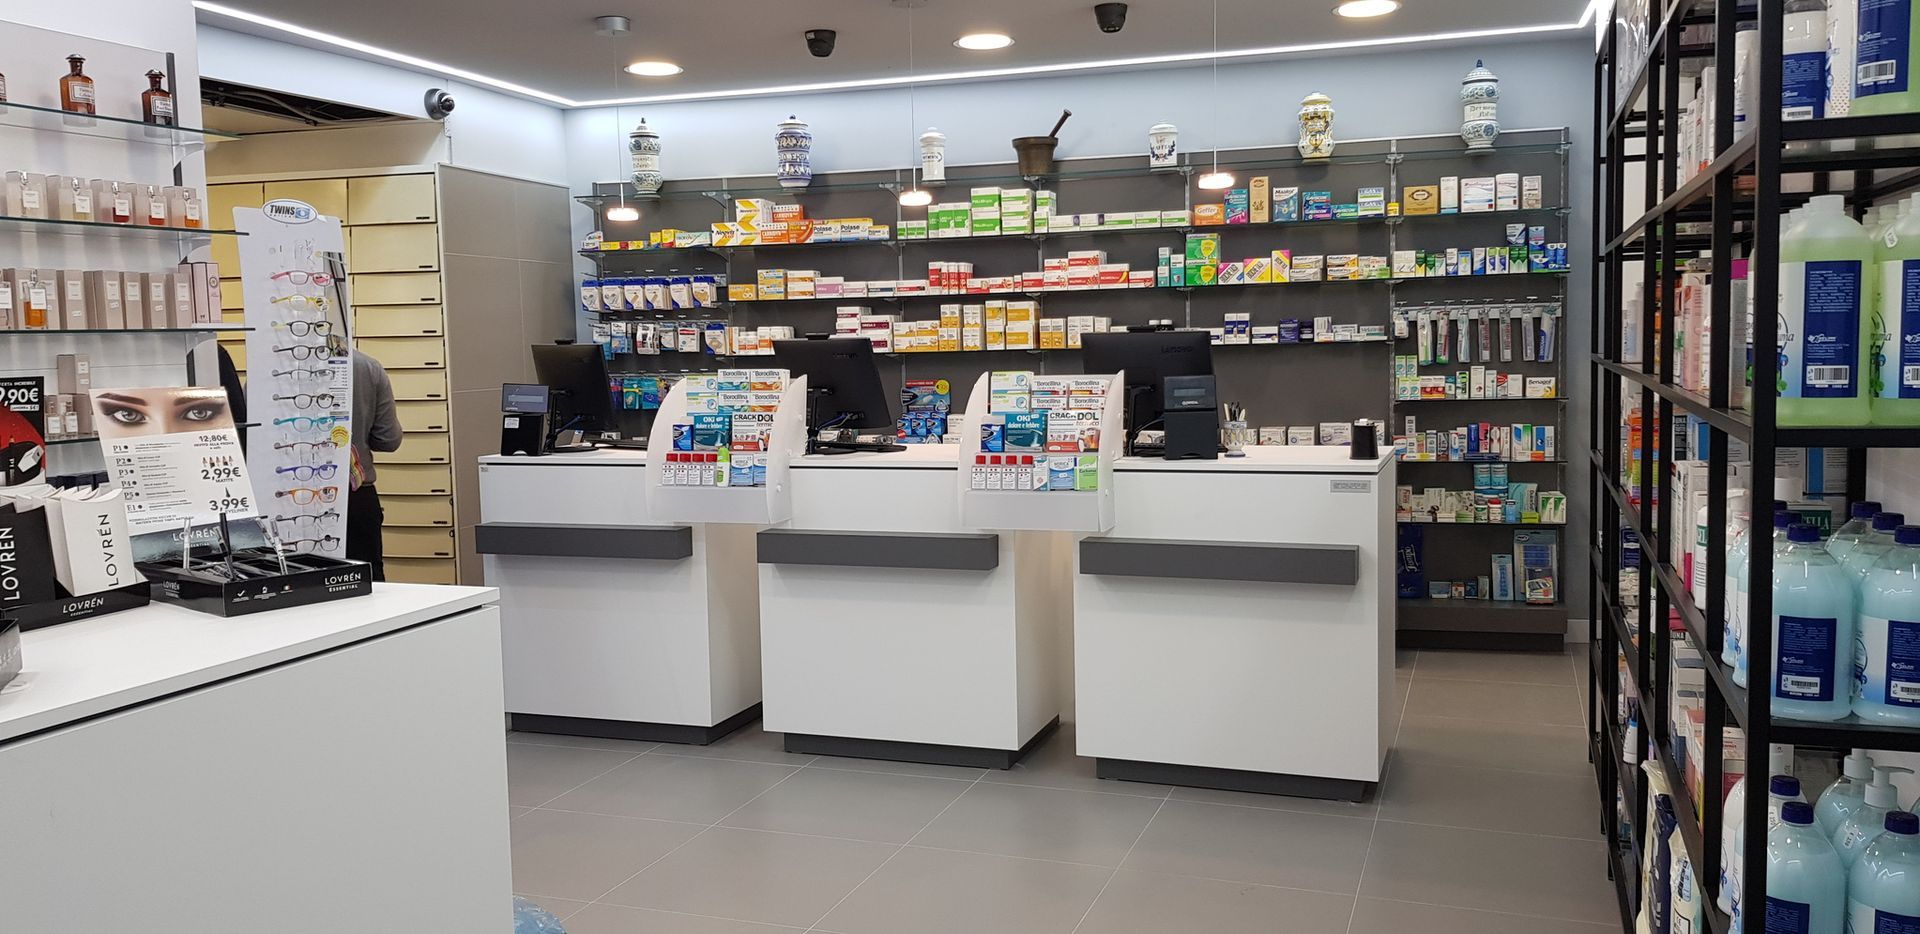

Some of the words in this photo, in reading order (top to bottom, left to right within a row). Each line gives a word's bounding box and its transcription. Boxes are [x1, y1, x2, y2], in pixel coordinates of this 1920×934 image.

[270, 204, 295, 215] TWINS
[841, 224, 860, 232] Polase
[1078, 412, 1099, 421] DOL
[199, 434, 228, 442] 12,80€
[200, 466, 242, 481] 2,99€
[208, 497, 250, 512] 3,99€
[97, 514, 120, 587] LOVRÉN
[324, 573, 362, 586] LOVRÉN
[328, 584, 359, 593] ESSENTIAL
[62, 597, 104, 614] LOVRÉN
